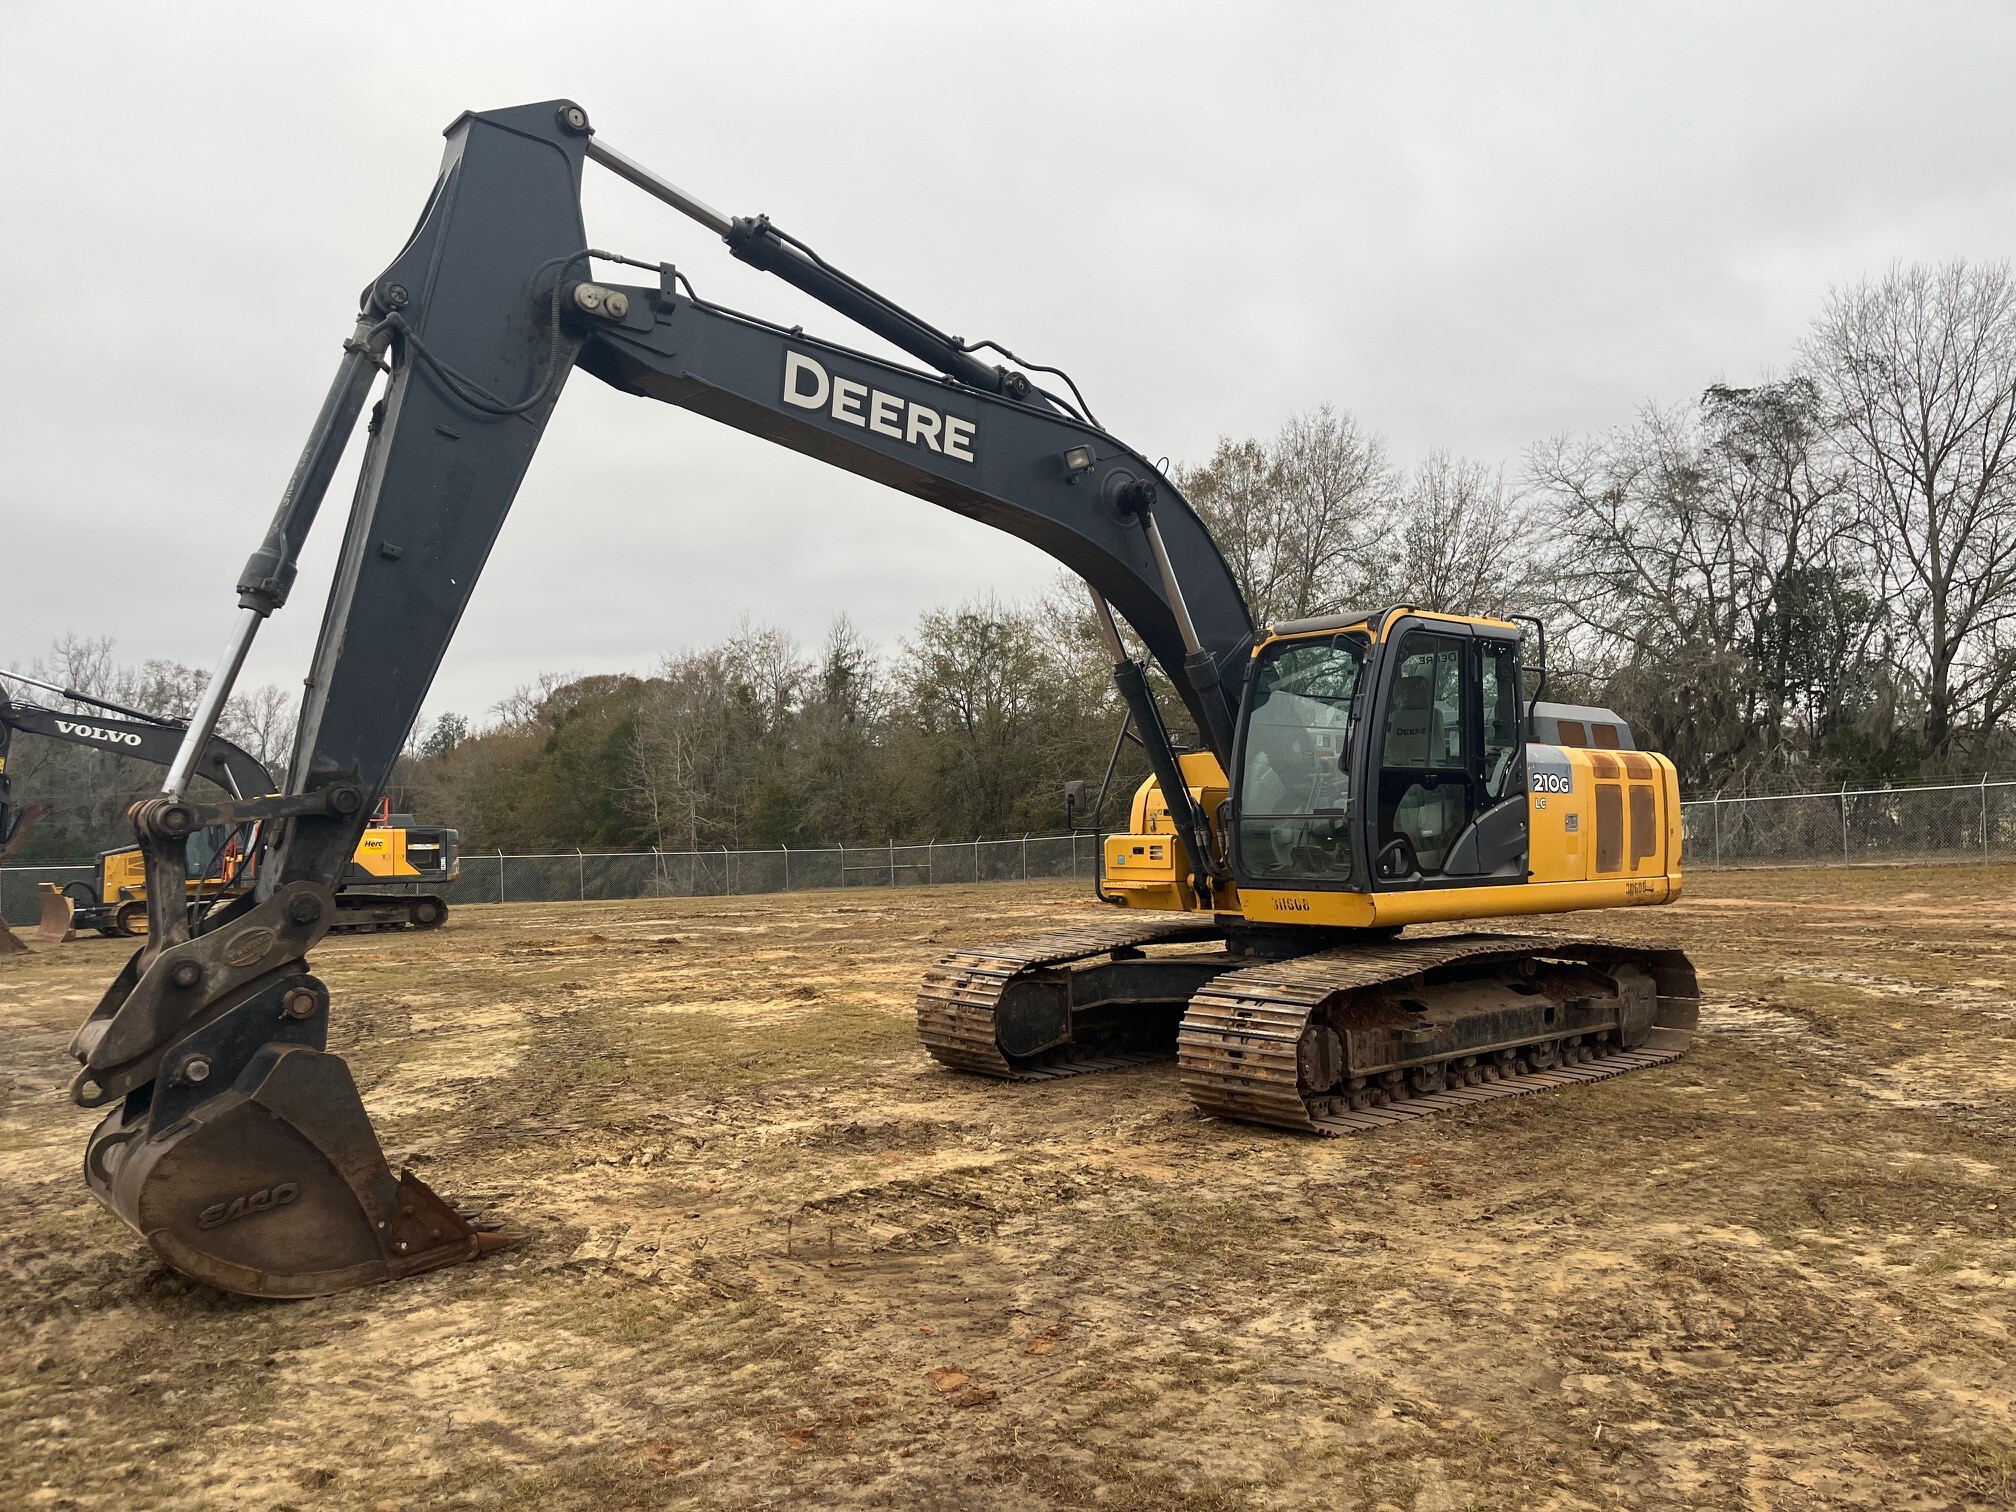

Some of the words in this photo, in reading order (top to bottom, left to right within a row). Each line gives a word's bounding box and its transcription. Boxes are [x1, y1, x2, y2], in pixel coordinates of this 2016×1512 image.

[783, 350, 976, 463] DEERE
[55, 720, 142, 746] VOLVO
[1396, 728, 1427, 736] DEERE
[1532, 773, 1570, 793] 210G
[1535, 798, 1547, 809] LC
